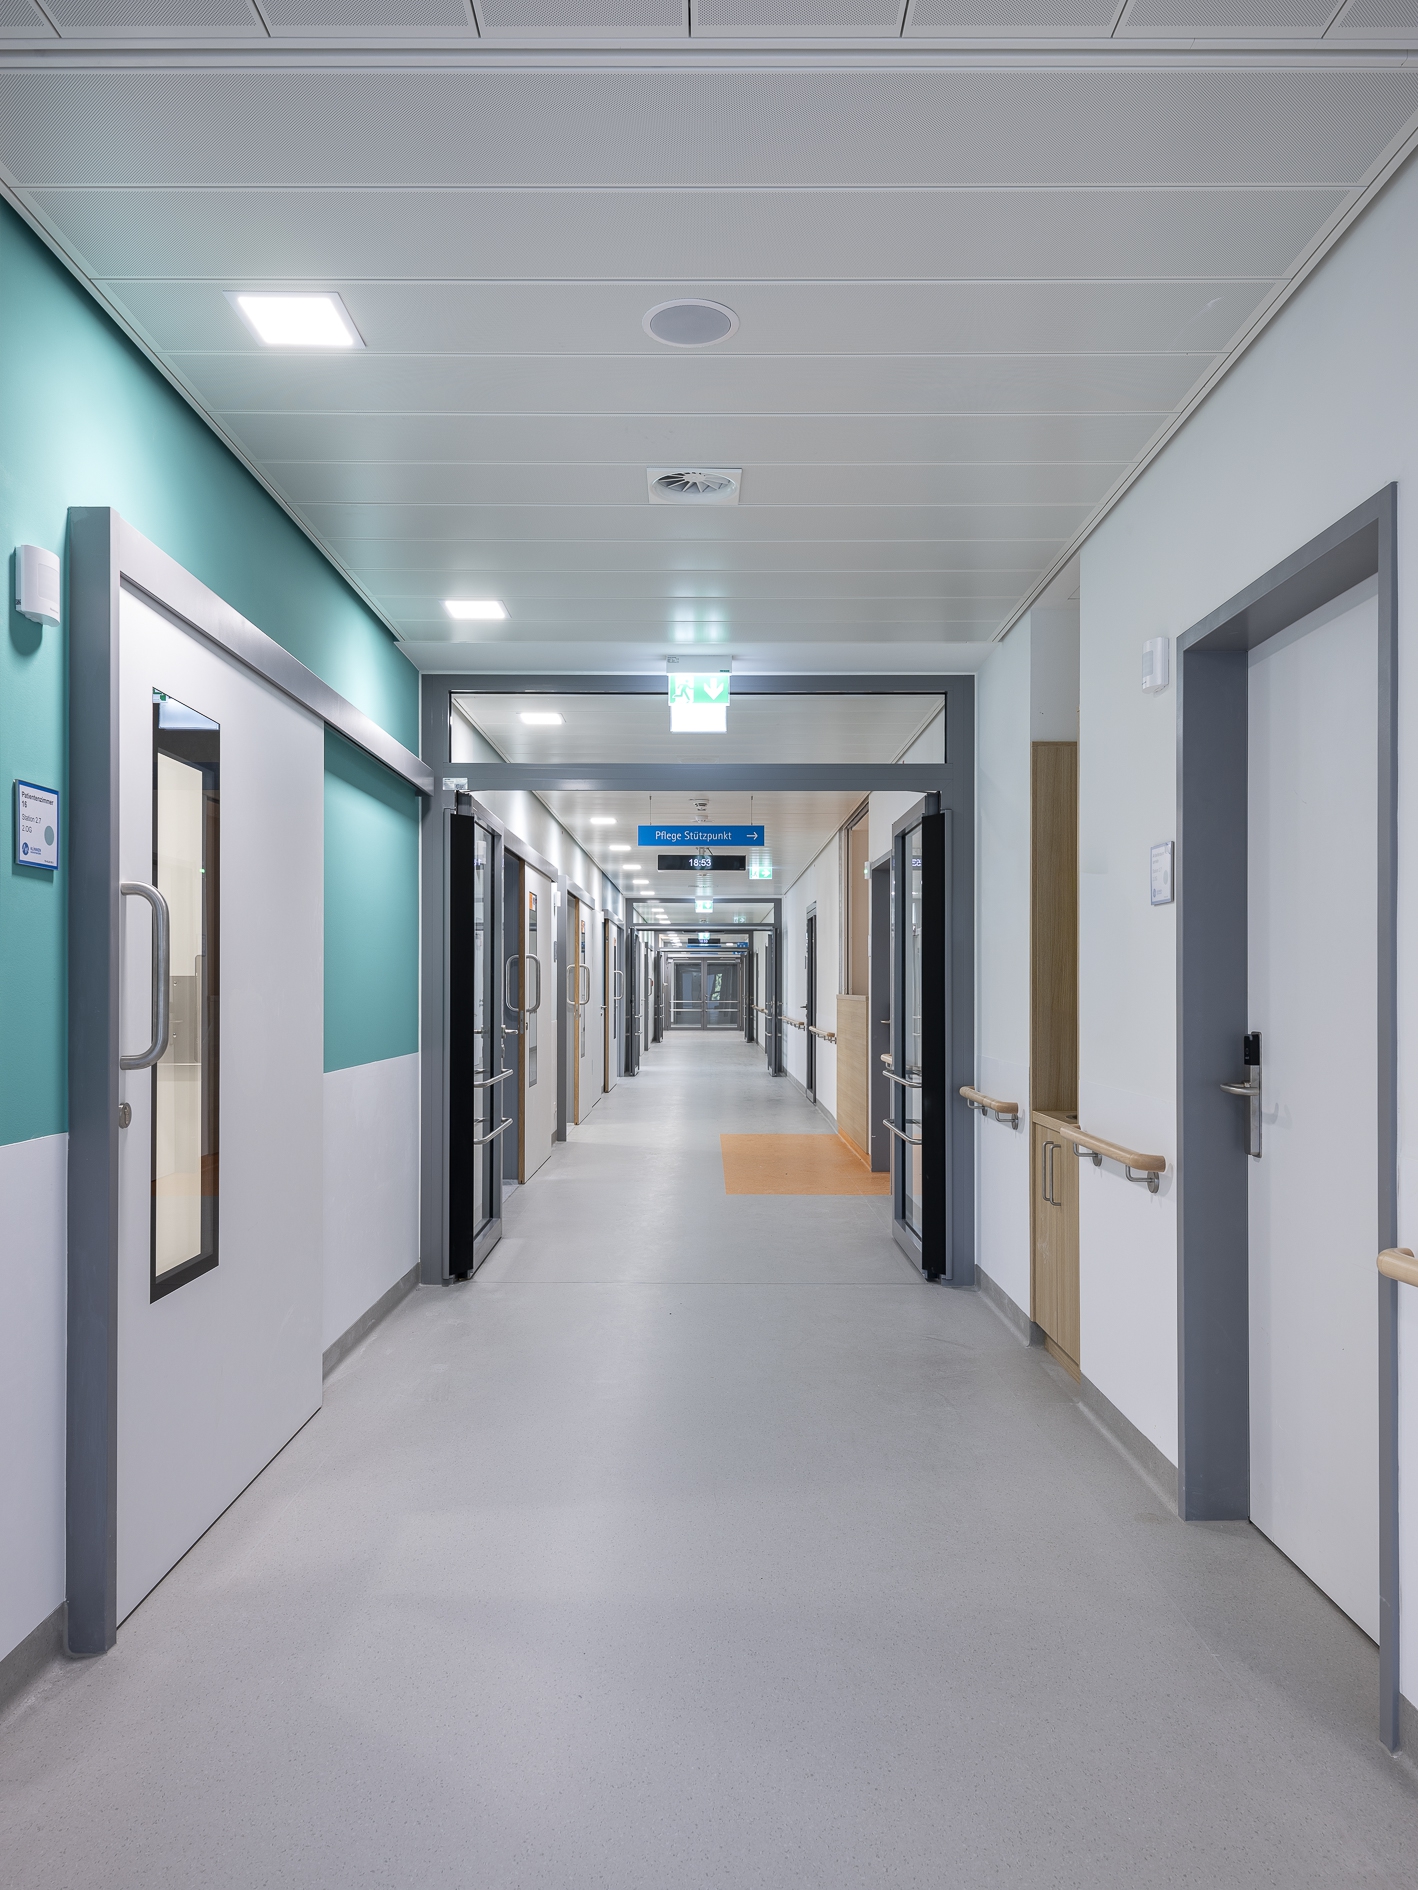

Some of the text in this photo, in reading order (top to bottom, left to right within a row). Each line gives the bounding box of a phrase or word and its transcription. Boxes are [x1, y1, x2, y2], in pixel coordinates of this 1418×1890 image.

[22, 791, 54, 805] Patientenzimmer
[22, 814, 35, 822] Station
[655, 830, 732, 842] Pflege Stützpunkt
[688, 859, 712, 867] 18:53
